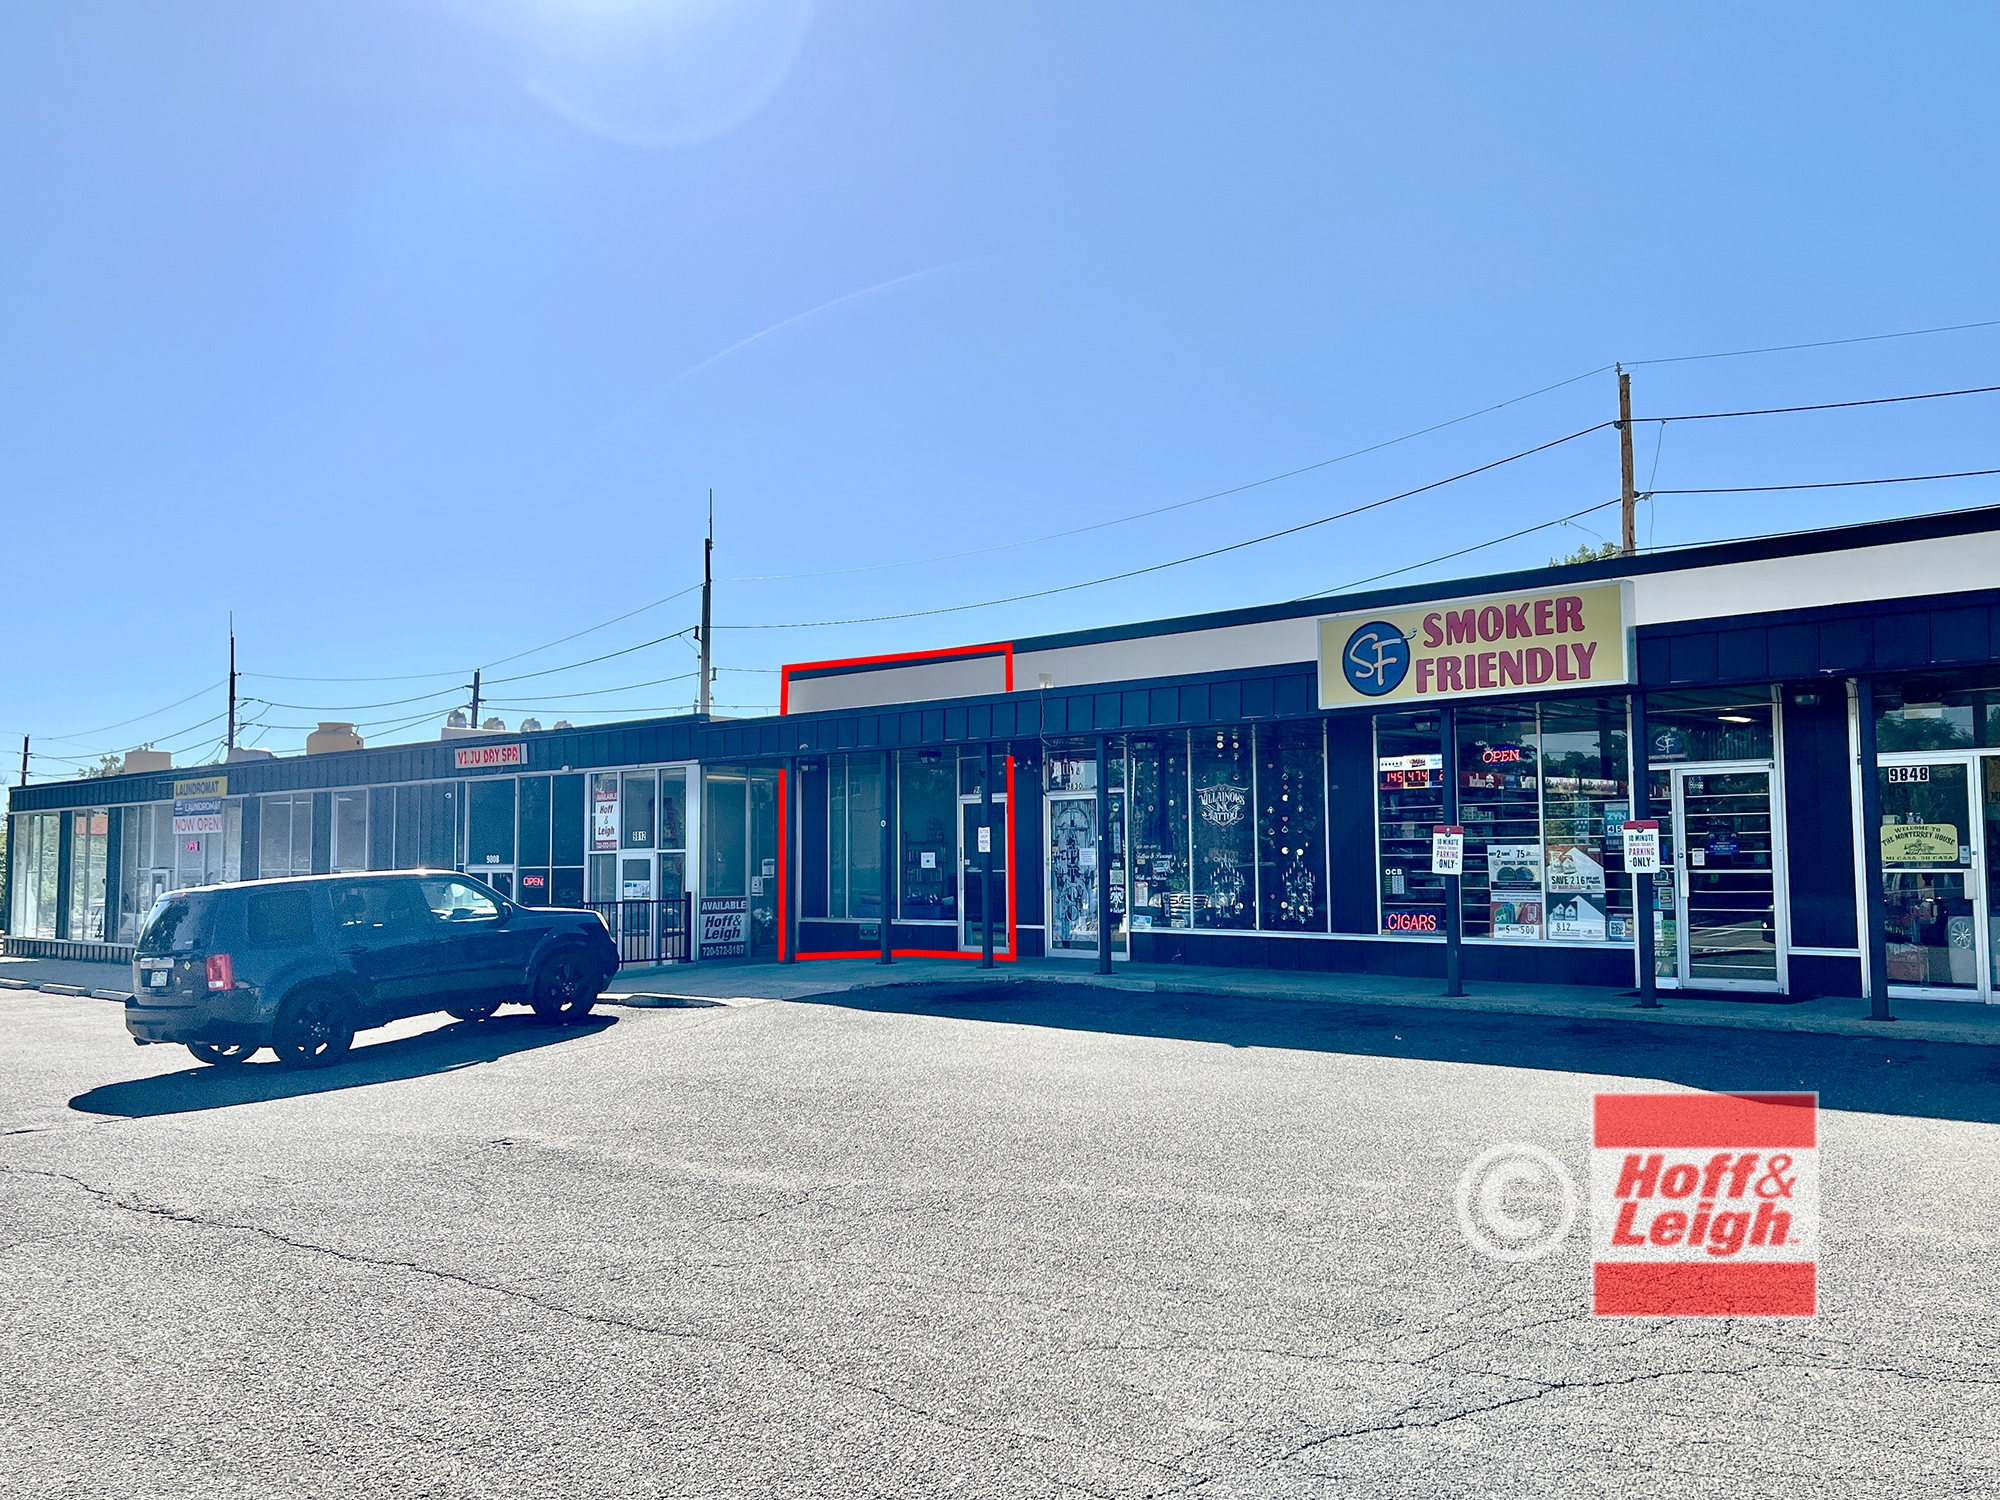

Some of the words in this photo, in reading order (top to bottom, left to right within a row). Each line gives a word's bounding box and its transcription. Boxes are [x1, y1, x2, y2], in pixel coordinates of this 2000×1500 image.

[1423, 596, 1585, 648] SMOKER
[1349, 632, 1404, 687] SF
[1416, 641, 1597, 694] FRIENDLY
[483, 748, 500, 763] DAY
[501, 746, 518, 762] SPA
[1482, 750, 1520, 764] OPEN
[1407, 770, 1428, 782] 474
[1889, 767, 1928, 782] 9848
[175, 780, 219, 796] LAUNDROMAT
[1198, 791, 1246, 805] VILLAINOUS
[184, 800, 221, 813] LAUNDROMAT
[600, 804, 613, 814] Hoff
[1607, 812, 1627, 820] ZYN
[175, 818, 194, 832] NOW
[1894, 825, 1930, 833] WELCOME
[598, 826, 615, 837] Leigh
[1443, 838, 1459, 846] MINUTE
[1635, 834, 1654, 842] MINUTE
[1881, 836, 1895, 846] THE
[1894, 830, 1932, 840] MONTERREY
[1934, 832, 1956, 846] HOUSE
[1436, 850, 1459, 859] PARKING
[1496, 849, 1501, 859] 2
[1516, 849, 1526, 859] 75
[1628, 847, 1655, 856] PARKING
[1385, 868, 1403, 876] OCB
[523, 876, 544, 886] OPEN
[1551, 875, 1569, 885] SAVE
[701, 900, 747, 911] AVAILABLE
[1388, 913, 1437, 931] CIGARS
[704, 927, 741, 941] Leigh
[1505, 925, 1510, 934] 5
[702, 944, 744, 956] 720-572-5187
